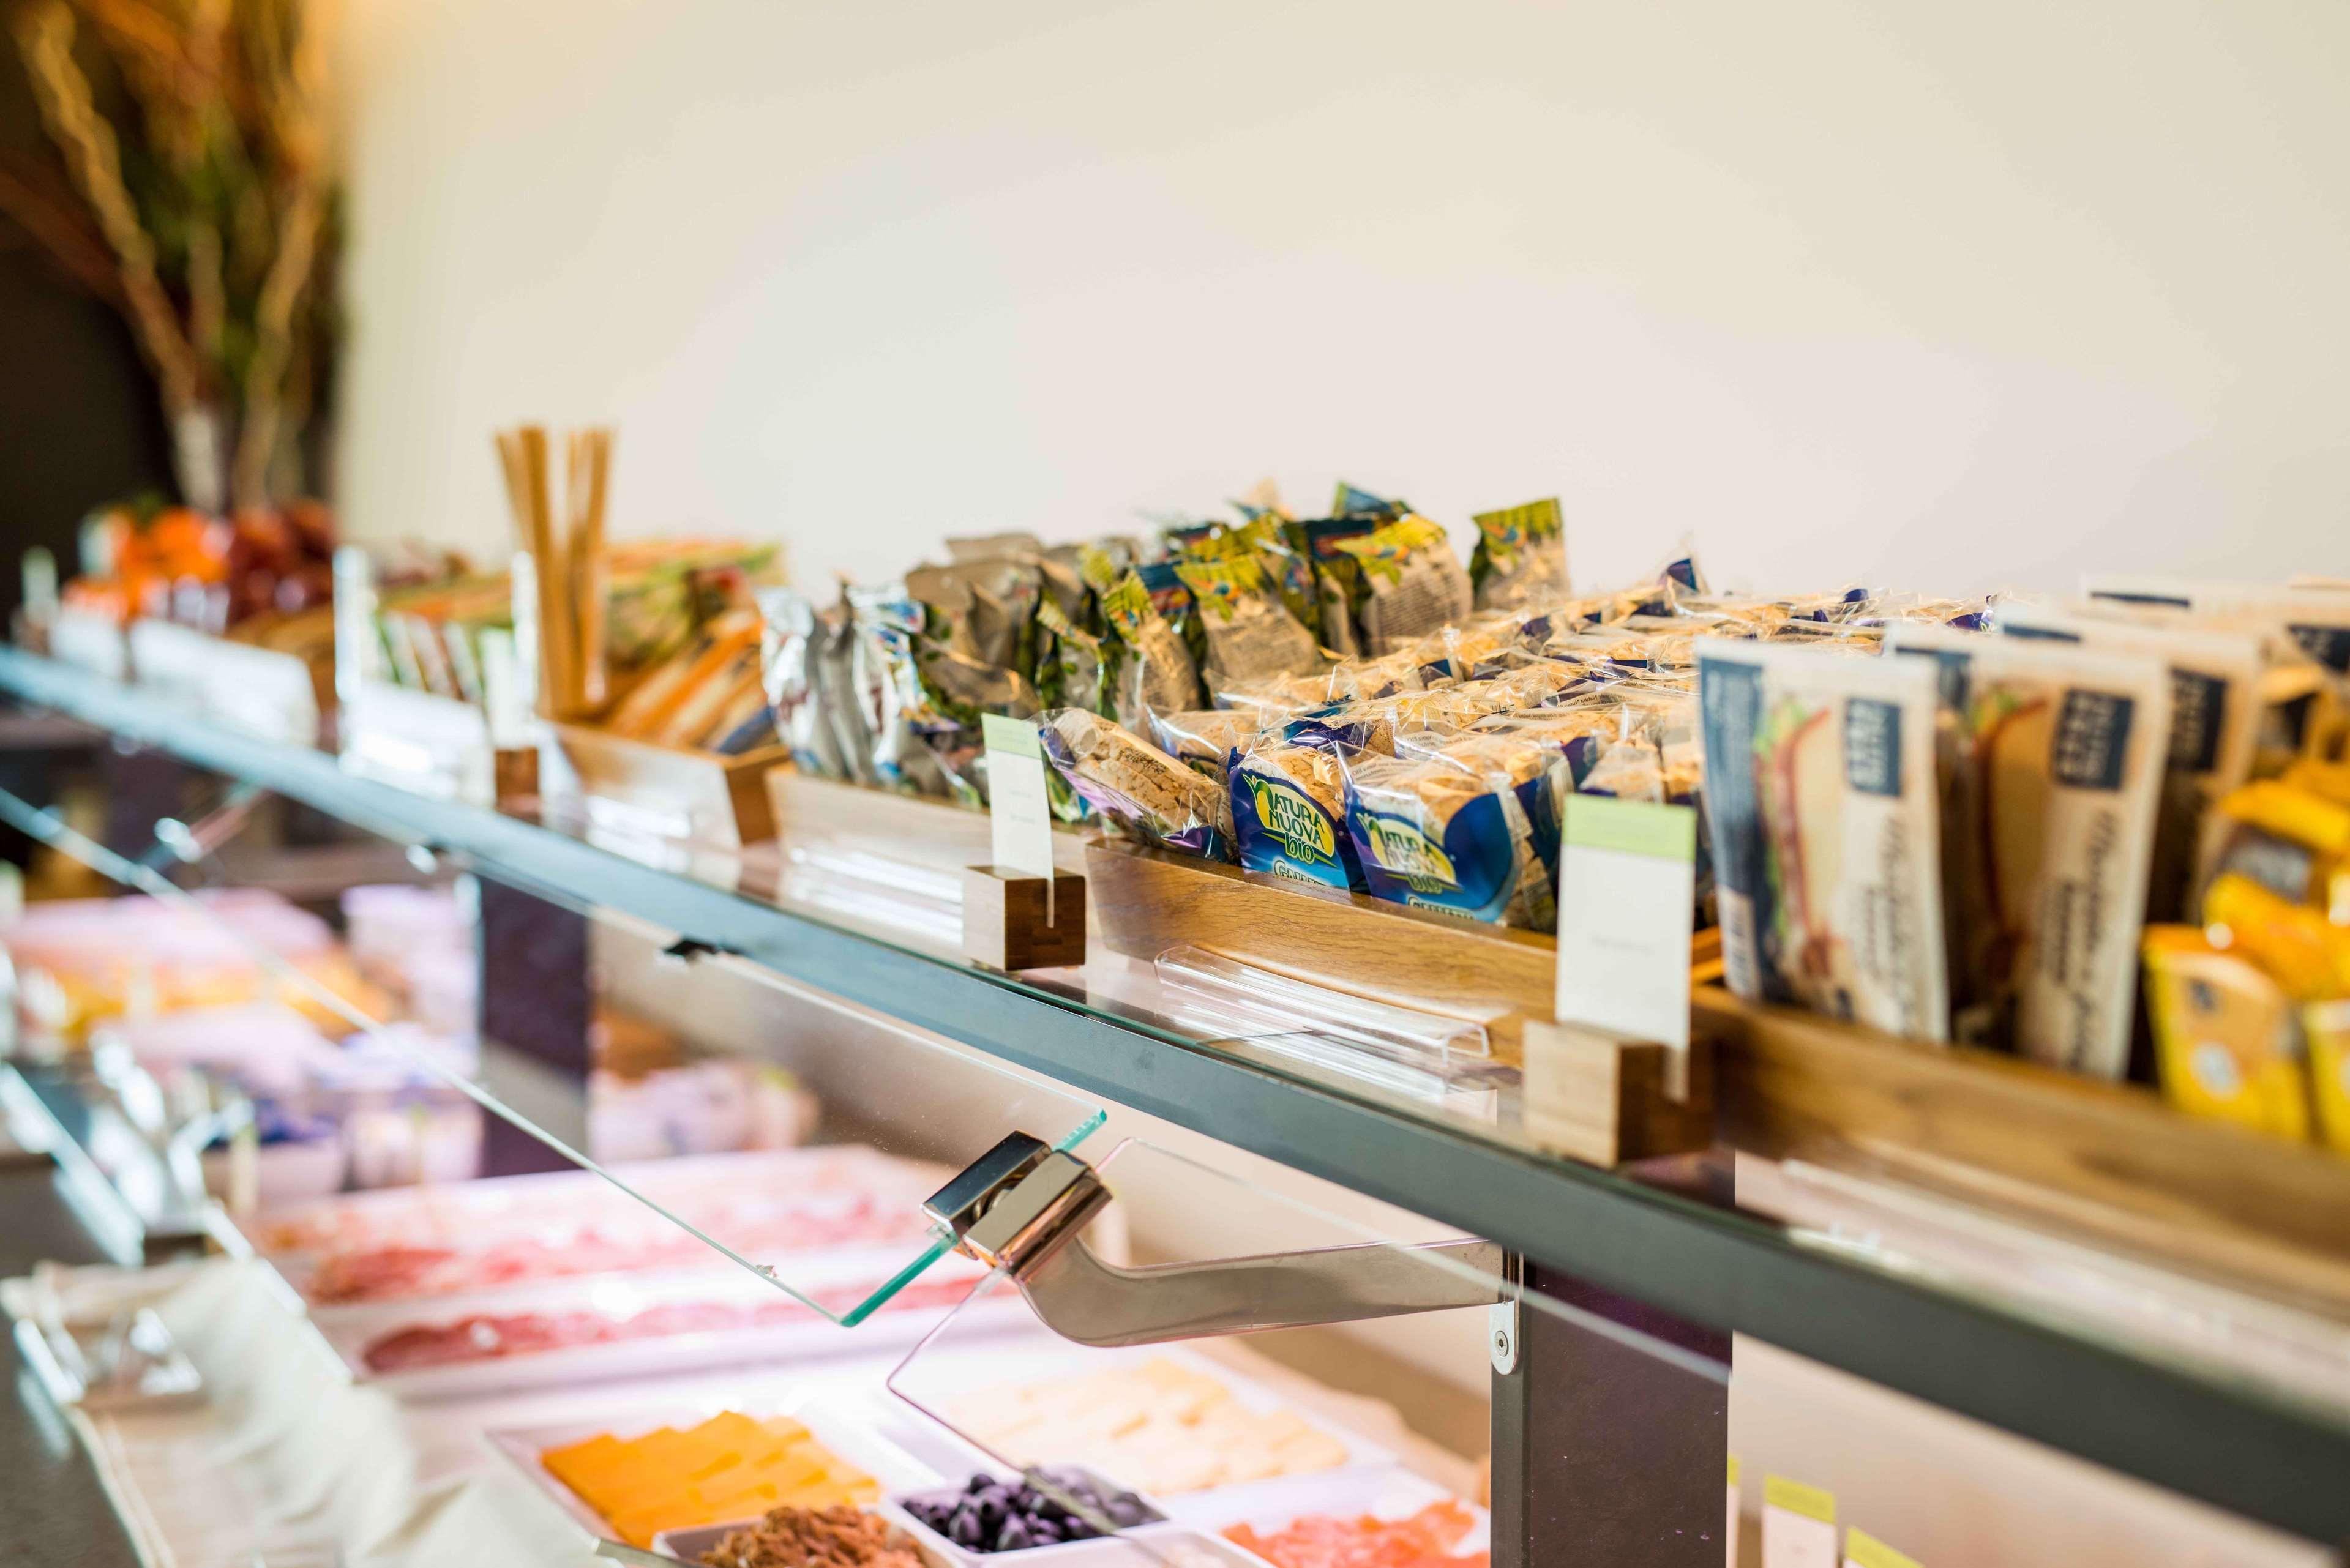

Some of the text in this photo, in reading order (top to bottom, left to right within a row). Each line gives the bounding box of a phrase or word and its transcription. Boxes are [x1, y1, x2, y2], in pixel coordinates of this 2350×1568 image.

[1243, 774, 1325, 834] NATURA
[1268, 809, 1325, 850] NUOVA
[1285, 832, 1315, 865] bio
